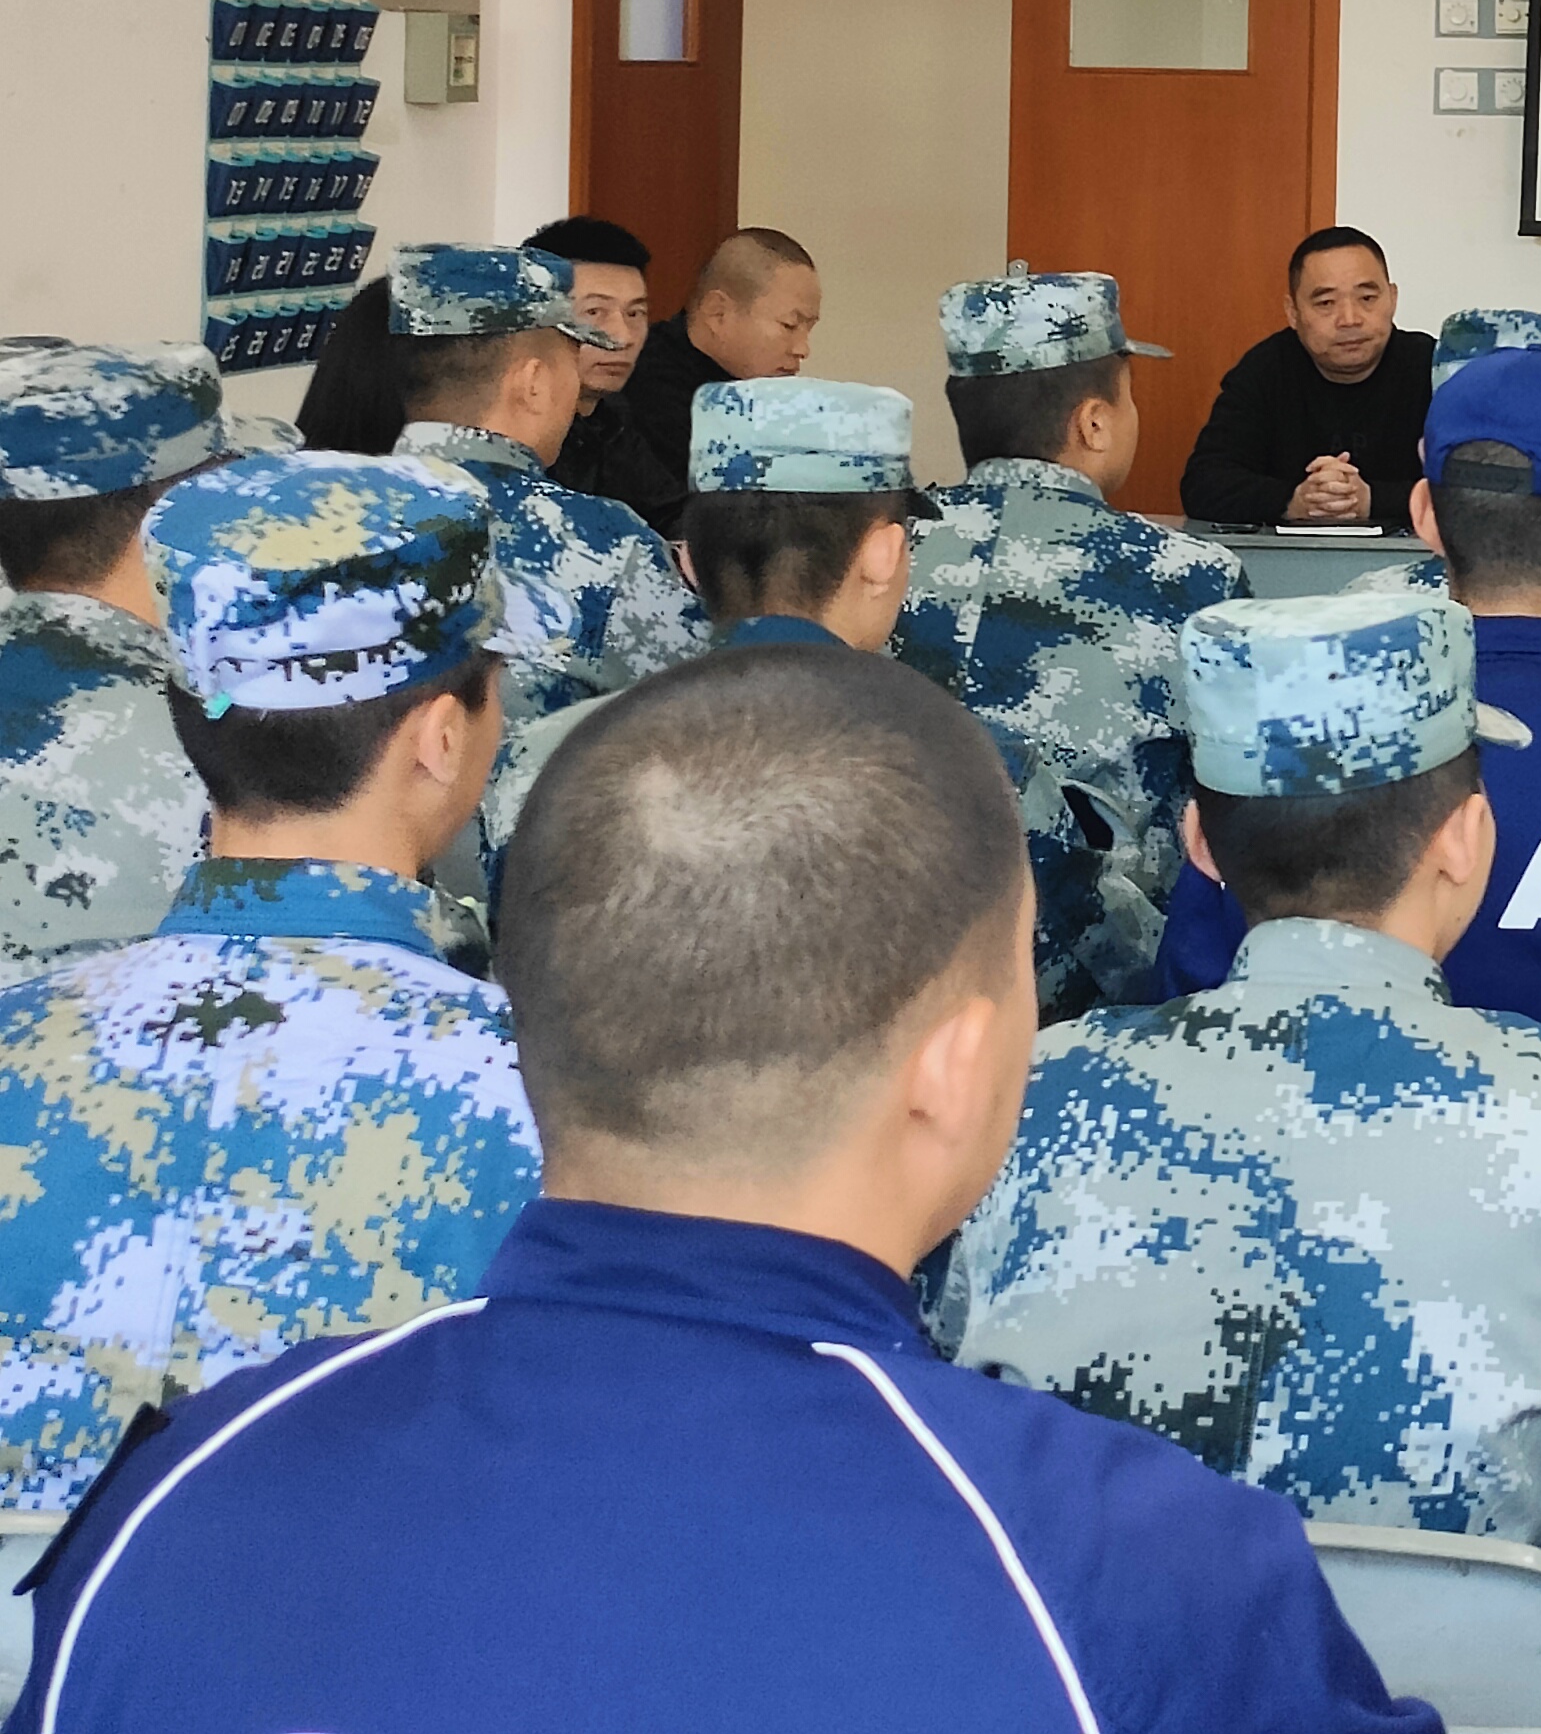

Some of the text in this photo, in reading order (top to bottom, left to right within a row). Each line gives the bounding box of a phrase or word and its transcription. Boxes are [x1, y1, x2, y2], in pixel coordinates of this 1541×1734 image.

[275, 251, 295, 275] 21
[301, 251, 321, 276] 22
[324, 247, 345, 271] 23
